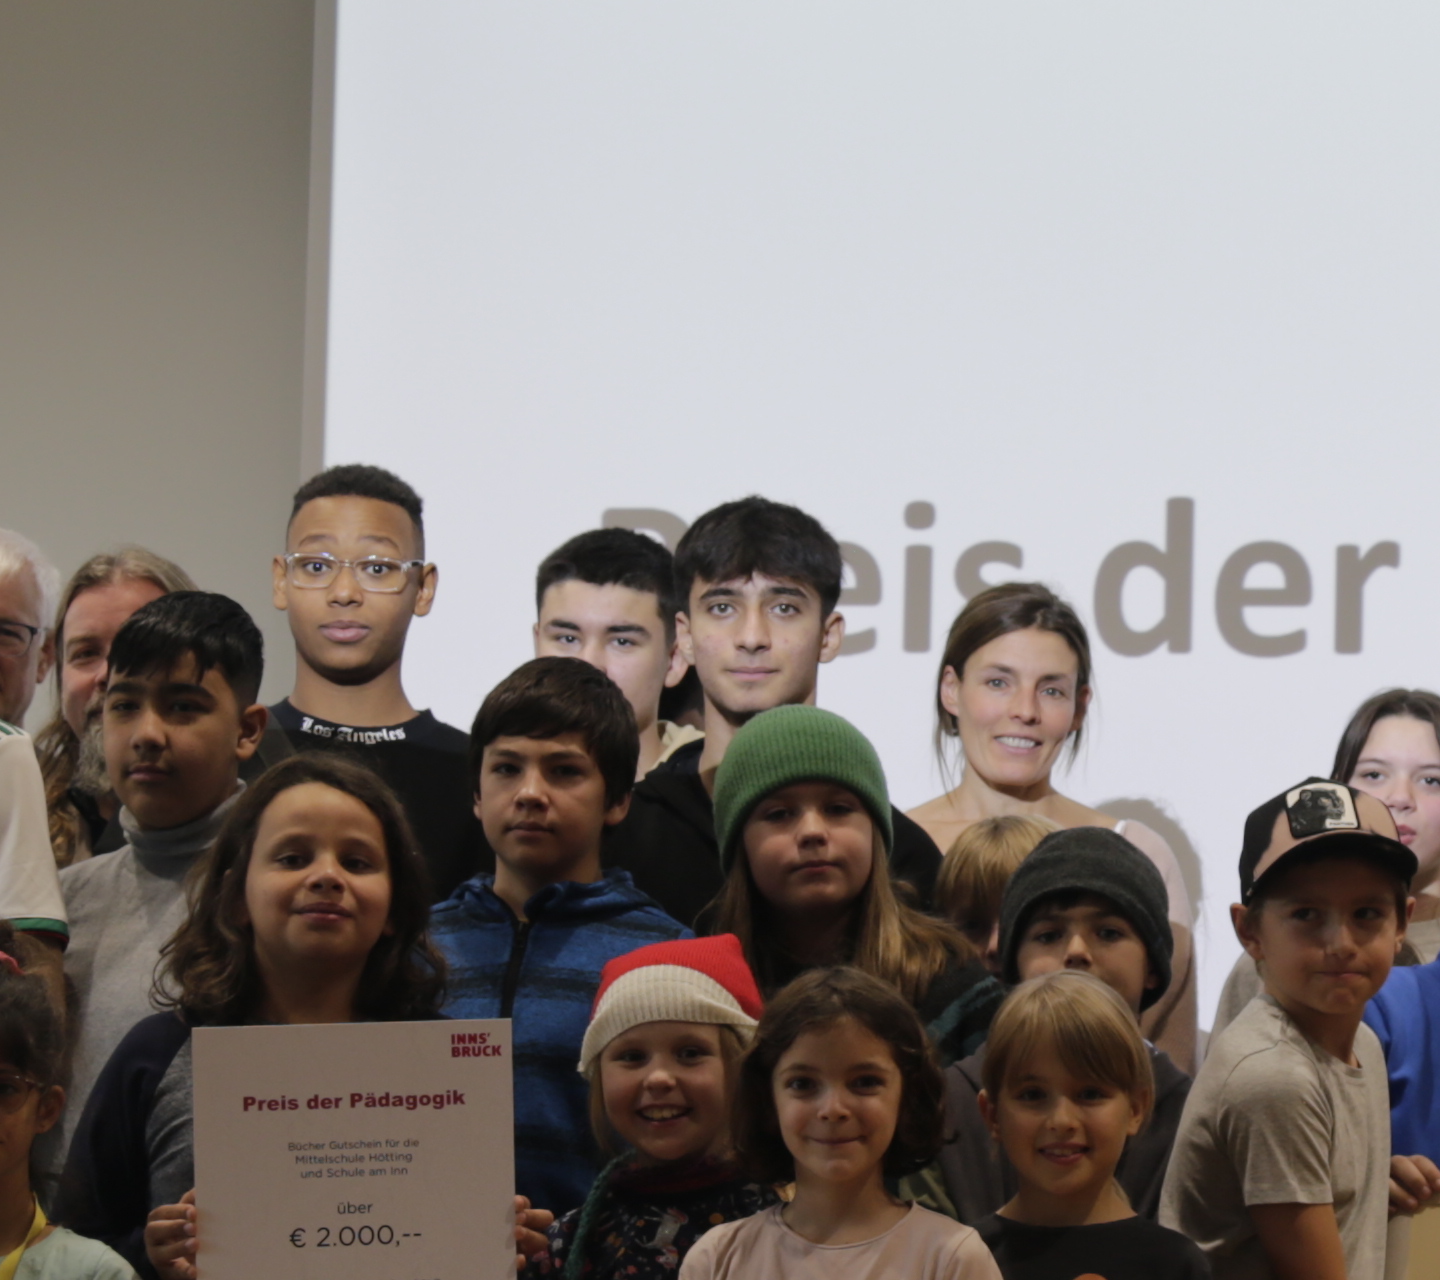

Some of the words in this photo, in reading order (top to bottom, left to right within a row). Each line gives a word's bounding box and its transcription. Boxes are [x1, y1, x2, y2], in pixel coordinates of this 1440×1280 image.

[1092, 497, 1401, 658] der
[300, 716, 334, 738] Los
[337, 726, 407, 746] Angeles
[451, 1045, 502, 1058] BRUCK
[243, 1095, 299, 1112] Preis
[306, 1094, 343, 1110] der
[350, 1089, 466, 1110] Pädagogik
[288, 1141, 326, 1152] Bücher
[329, 1138, 382, 1151] Gutschein
[385, 1138, 400, 1148] für
[403, 1137, 420, 1148] die
[295, 1152, 365, 1165] Mittelschule
[369, 1151, 413, 1164] Hötting
[301, 1167, 323, 1179] und
[327, 1166, 365, 1178] Schule
[368, 1167, 387, 1177] am
[390, 1166, 408, 1176] Inn
[337, 1201, 374, 1215] über
[289, 1228, 306, 1248] €
[316, 1224, 422, 1248] 2.000,--
